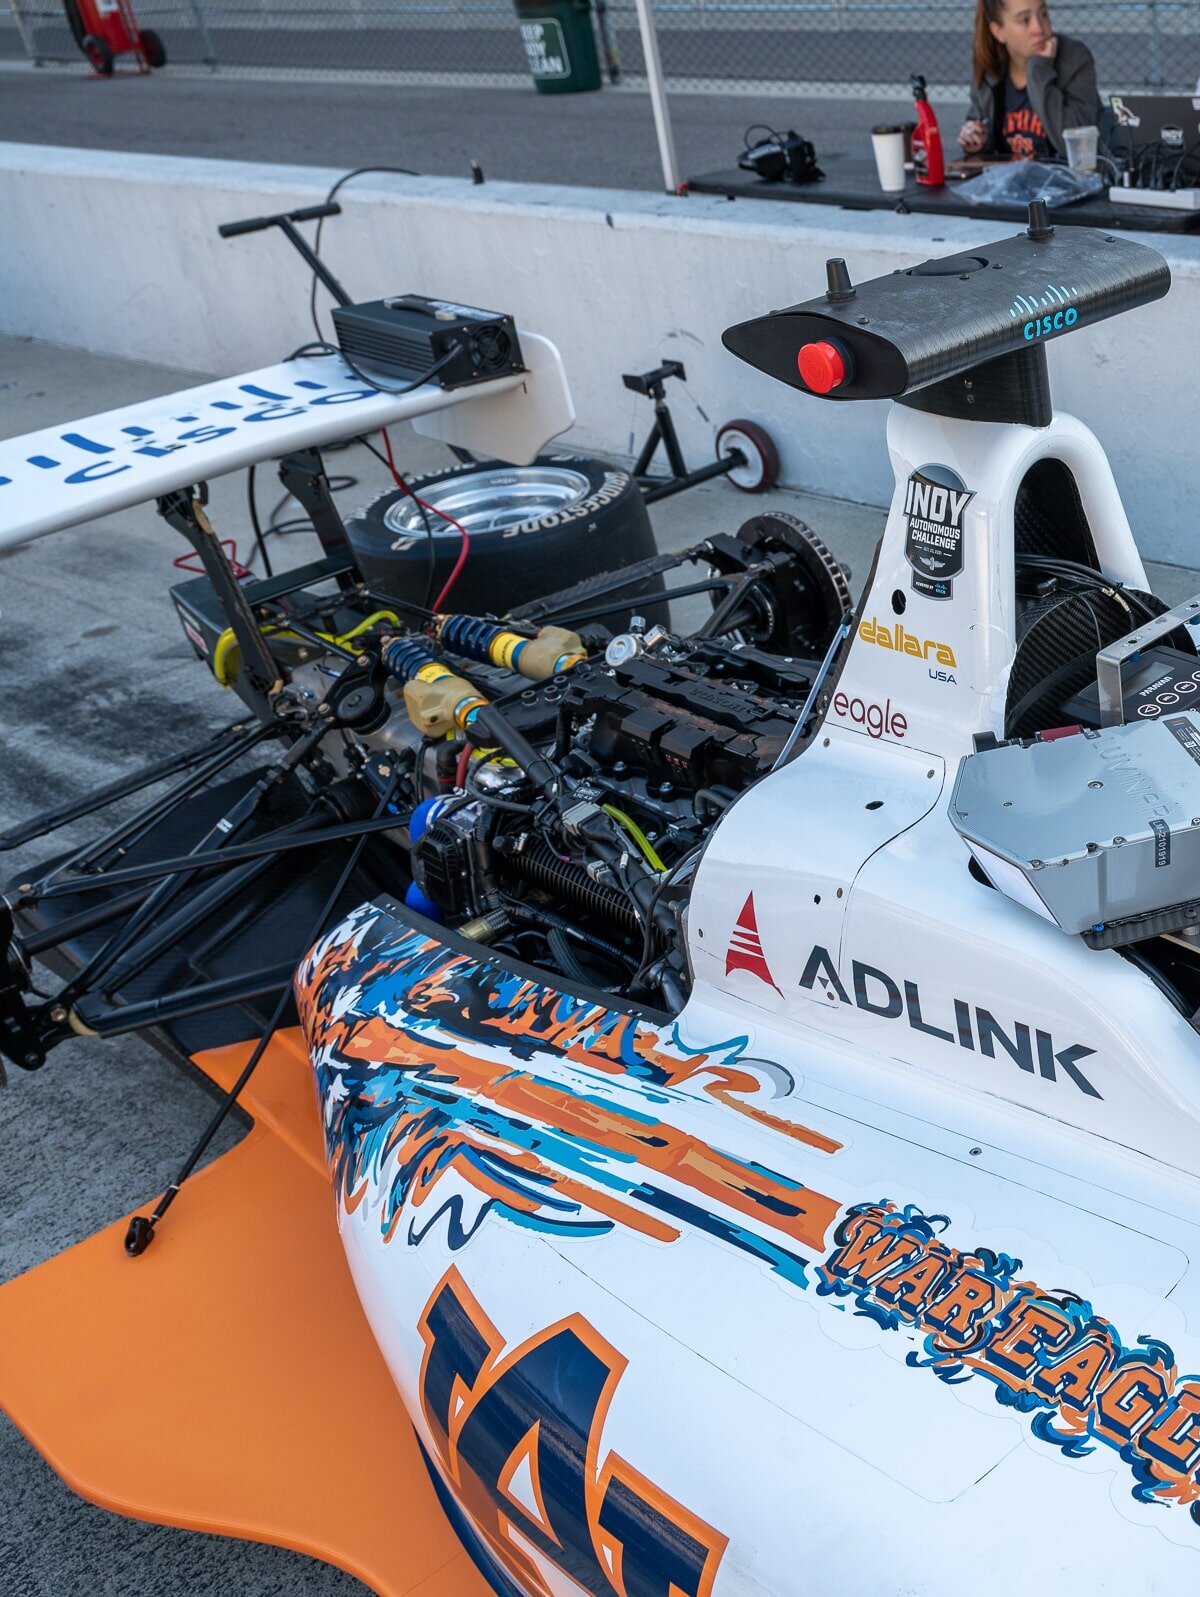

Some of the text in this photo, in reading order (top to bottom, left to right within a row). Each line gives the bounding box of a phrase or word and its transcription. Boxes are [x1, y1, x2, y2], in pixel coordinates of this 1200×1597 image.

[1023, 307, 1079, 341] CISCO
[63, 389, 381, 484] CISCO
[502, 471, 629, 539] BRIDGESTONE
[905, 480, 971, 527] INDY
[909, 517, 961, 540] AUTONOMOUS
[911, 530, 957, 551] CHALLENGE
[858, 617, 957, 668] dallara
[928, 668, 958, 685] USA
[833, 692, 909, 739] eagle
[1151, 819, 1168, 866] LM-2101919
[799, 945, 1106, 1101] ADLINK
[826, 1220, 999, 1343] WAR
